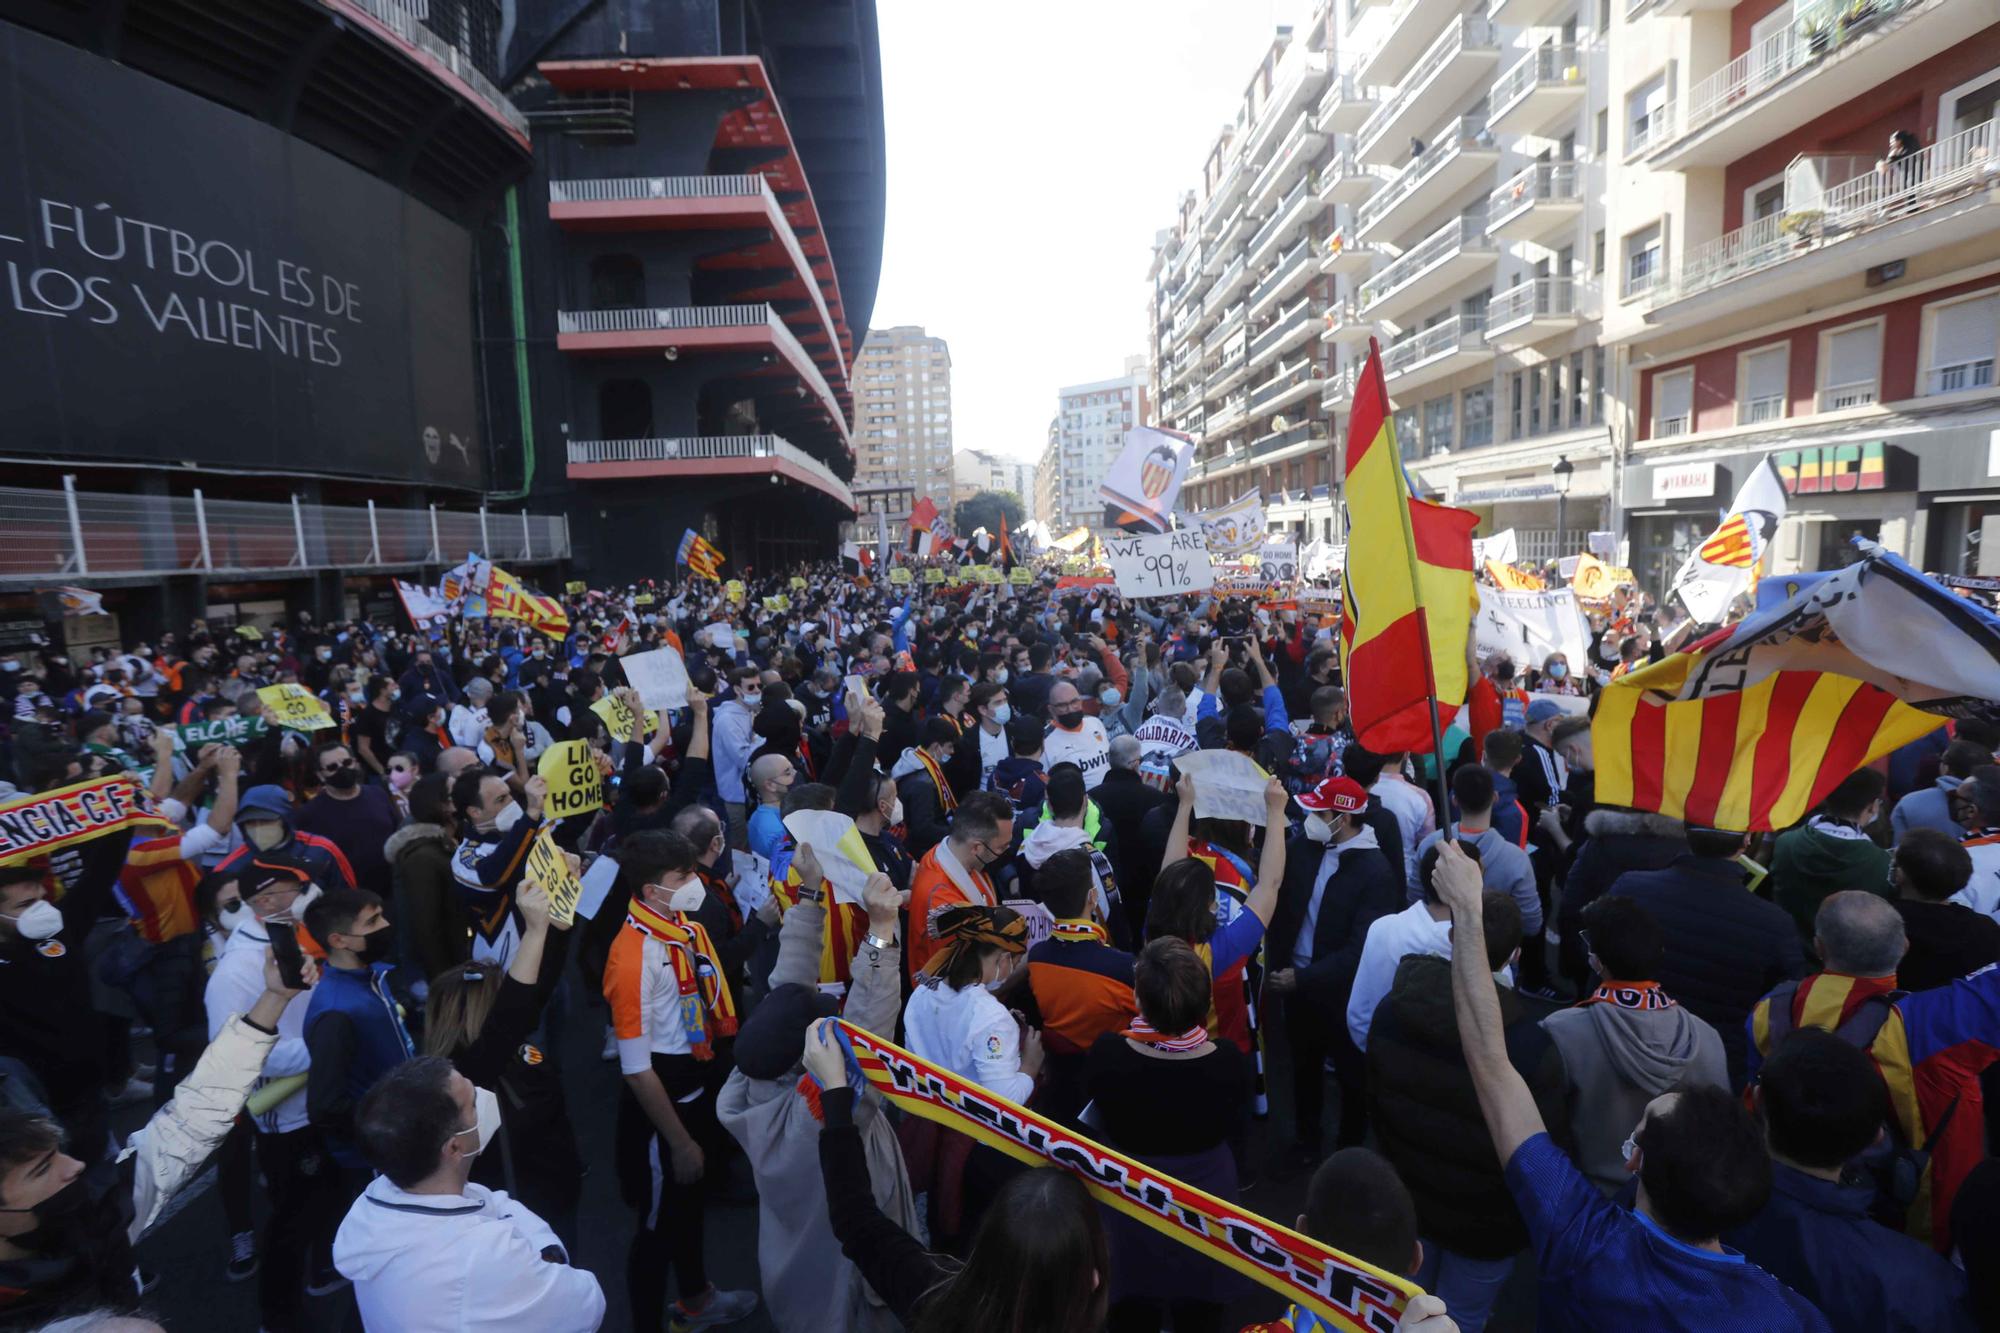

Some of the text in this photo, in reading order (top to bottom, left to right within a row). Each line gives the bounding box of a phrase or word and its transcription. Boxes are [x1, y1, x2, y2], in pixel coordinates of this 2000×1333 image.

[40, 198, 362, 323] FÚTBOL ES DE
[7, 261, 341, 367] LOS VALIENTES
[1670, 473, 1708, 489] YAMAHA
[1112, 531, 1202, 557] WE ARE
[1263, 551, 1293, 560] GO HOME
[1500, 593, 1567, 610] FEELING
[287, 702, 306, 715] GO
[616, 705, 636, 722] GO
[185, 717, 249, 743] ELCHE
[569, 767, 594, 787] GO
[551, 785, 603, 813] HOME
[528, 838, 554, 882] LIM
[546, 868, 560, 893] GO
